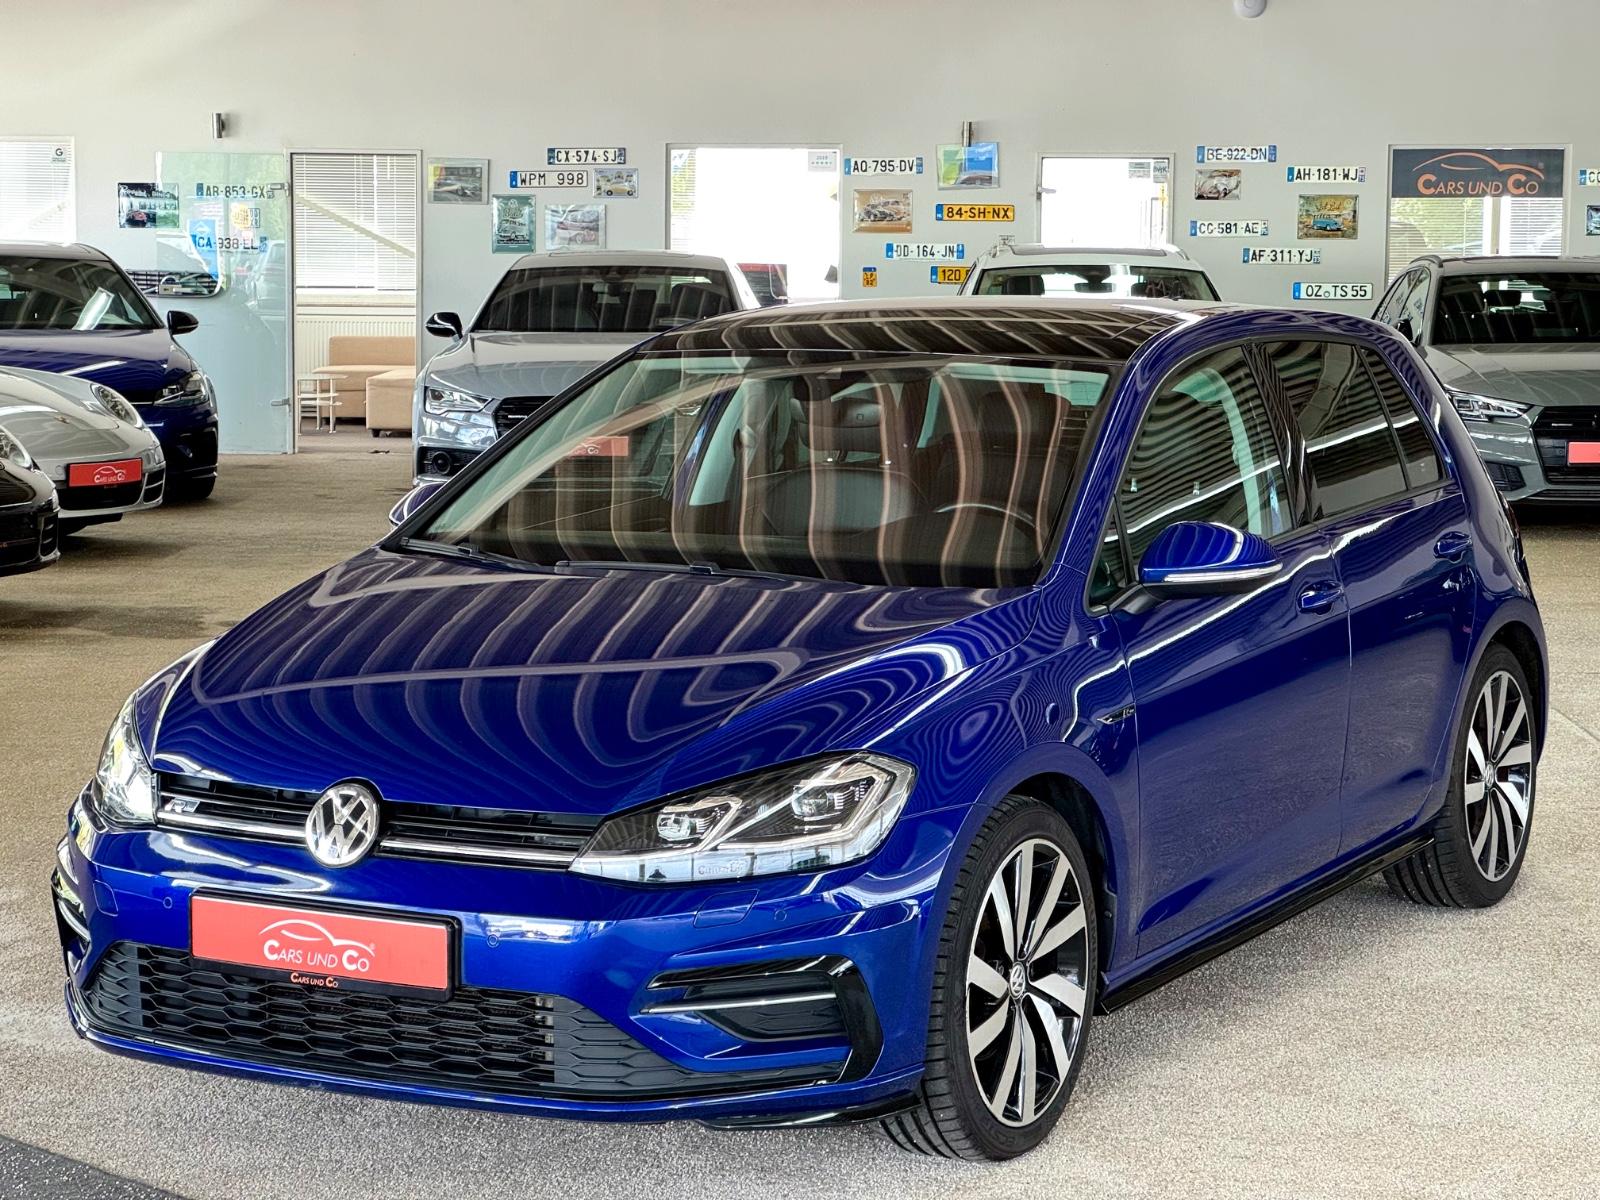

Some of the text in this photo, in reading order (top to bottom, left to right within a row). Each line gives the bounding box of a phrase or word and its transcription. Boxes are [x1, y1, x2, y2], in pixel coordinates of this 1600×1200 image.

[556, 150, 617, 162] CX-574-SJ
[1206, 147, 1267, 161] BE-922-DN
[852, 159, 915, 173] AQ-795-DV
[519, 172, 584, 186] WPM 998
[1295, 167, 1358, 181] AH-181-WJ
[1468, 181, 1503, 195] UND
[946, 206, 1010, 220] 84-SH-NX
[1250, 249, 1313, 263] AF-311-YJ
[941, 268, 961, 282] 120
[1305, 285, 1367, 298] OZ TS 55
[306, 951, 339, 968] UND
